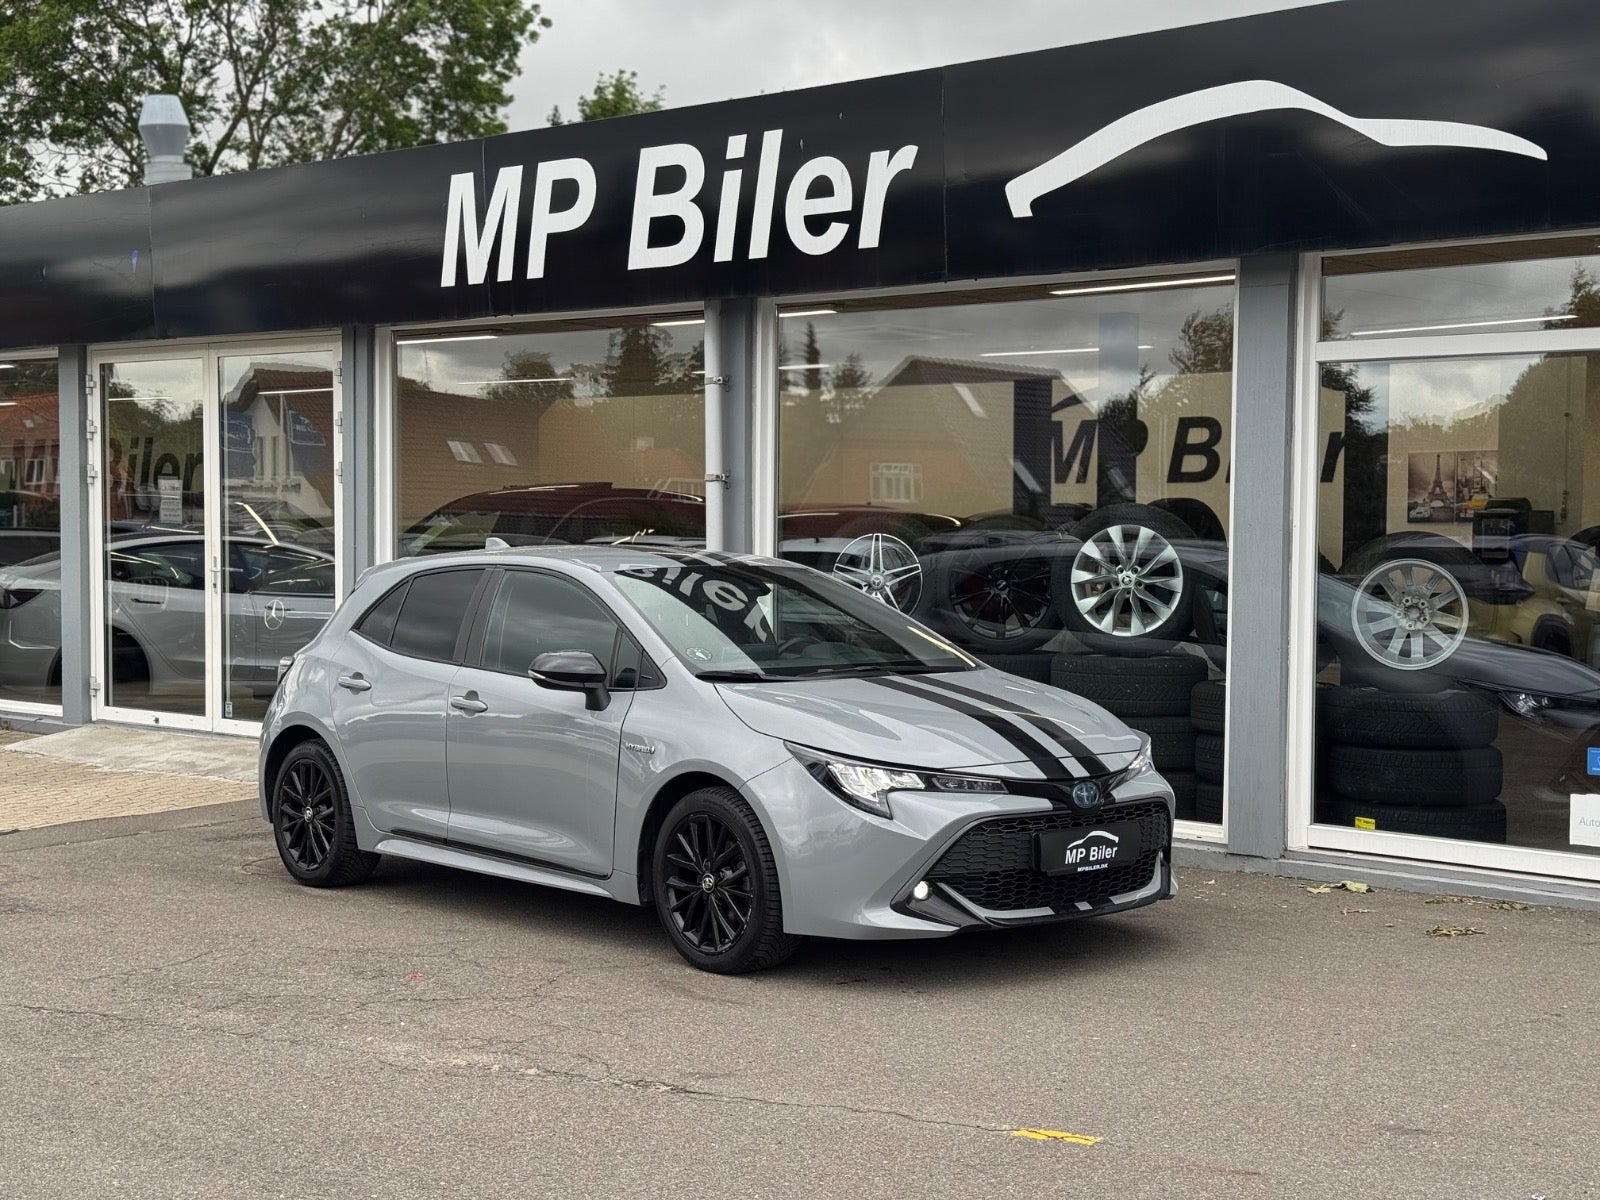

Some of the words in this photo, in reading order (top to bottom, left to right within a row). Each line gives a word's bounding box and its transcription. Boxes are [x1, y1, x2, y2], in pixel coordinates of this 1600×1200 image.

[441, 157, 597, 287] MP
[627, 129, 919, 270] Biler
[1065, 848, 1086, 864] MP
[1089, 845, 1118, 861] Biler
